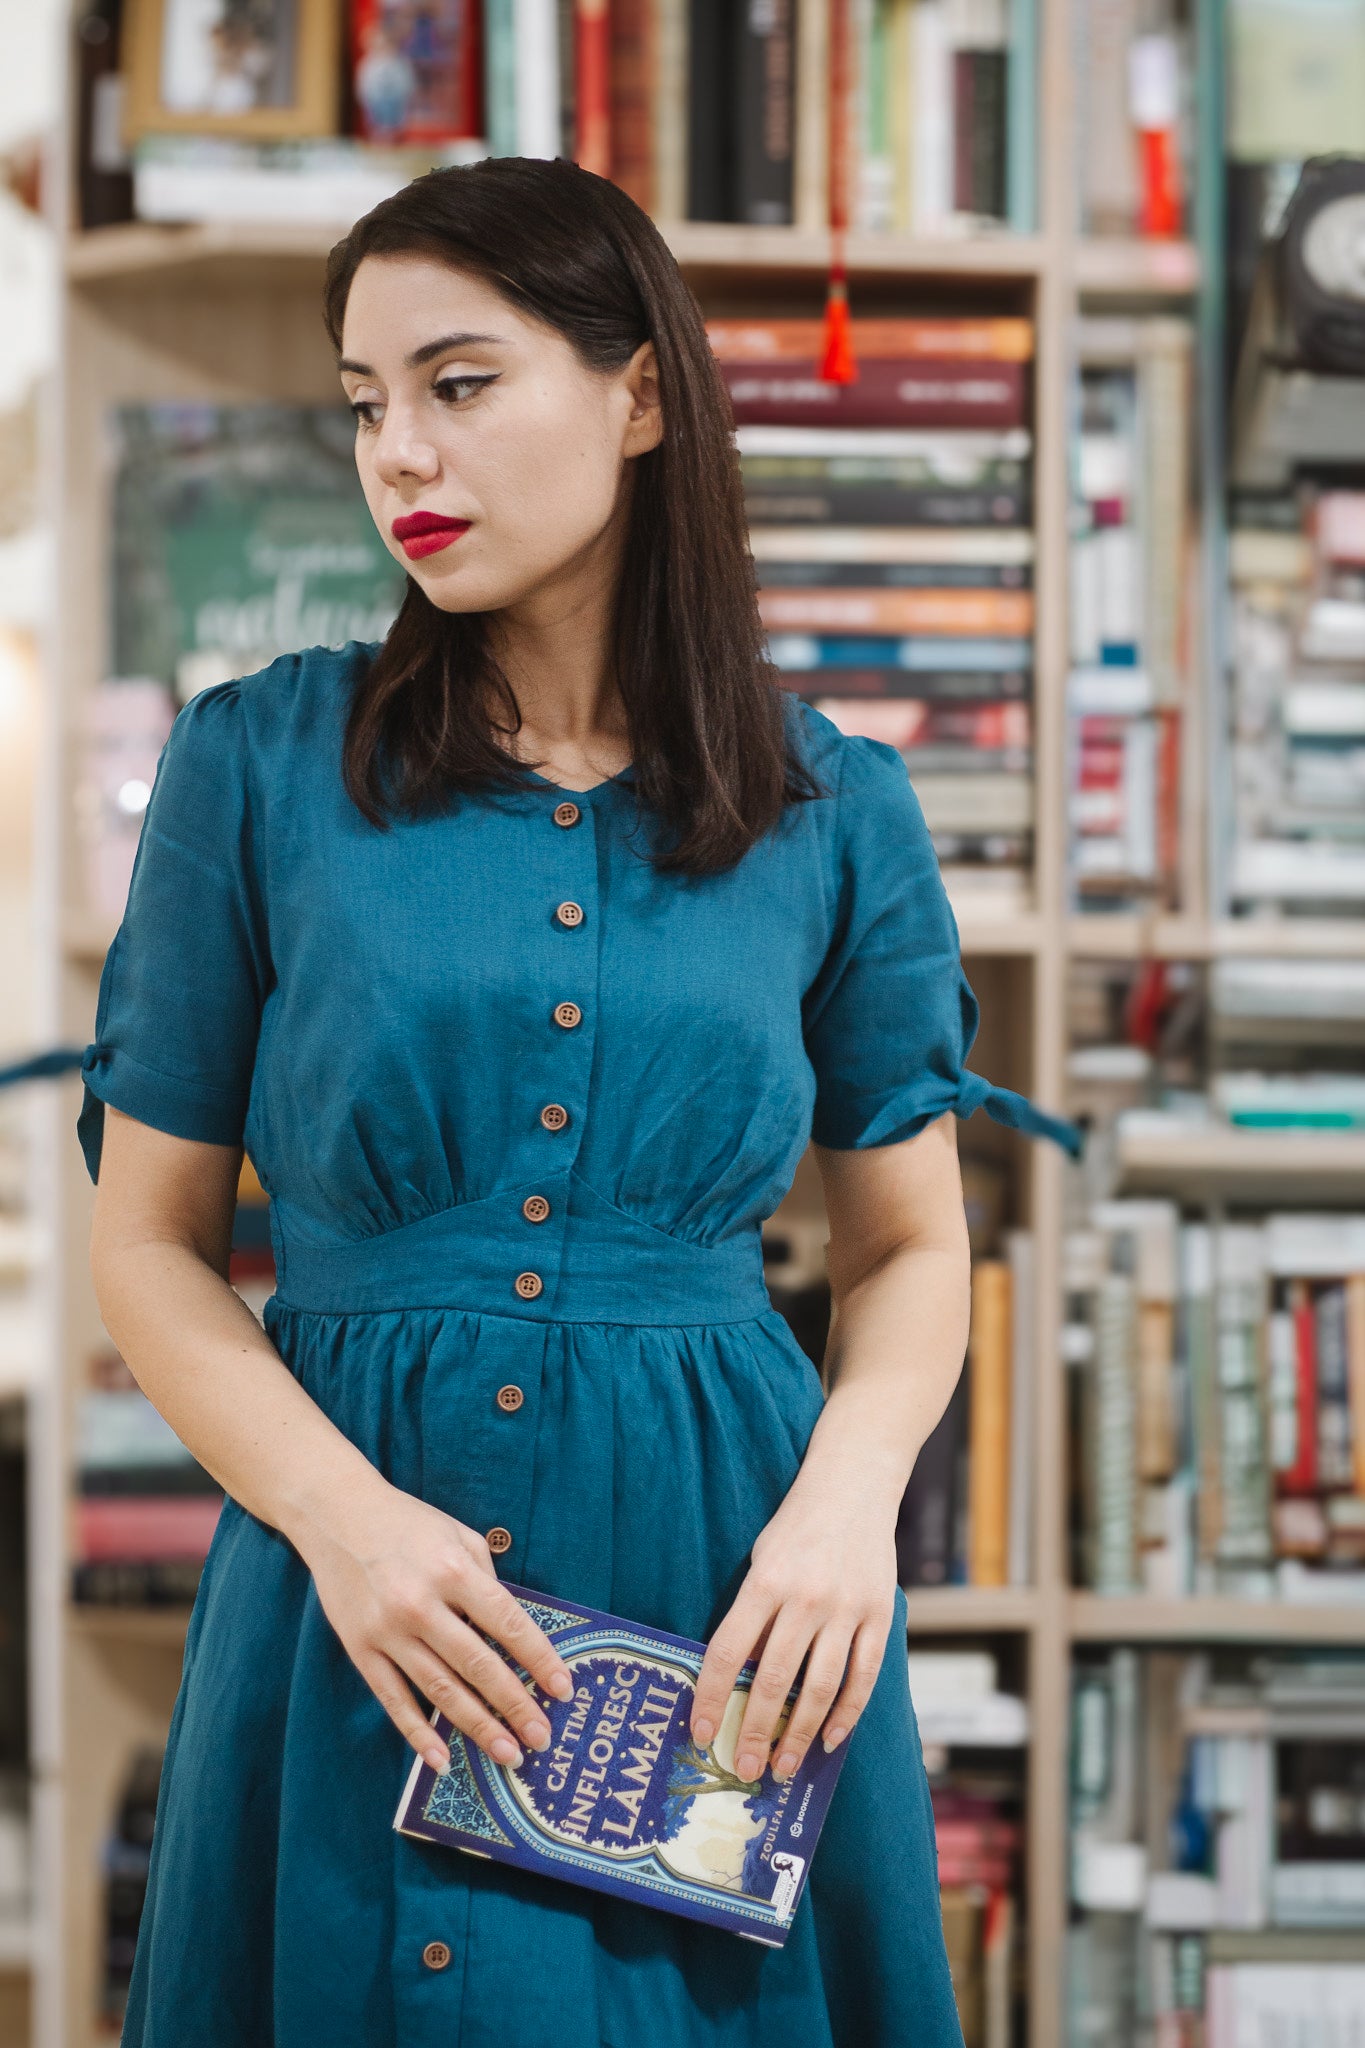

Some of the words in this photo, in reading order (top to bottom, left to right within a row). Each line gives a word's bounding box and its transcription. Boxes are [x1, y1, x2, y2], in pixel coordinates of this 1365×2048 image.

[560, 1686, 594, 1742] TIMP
[546, 1745, 575, 1792] CÂT
[560, 1665, 641, 1836] ÎNFLORESC
[601, 1683, 680, 1840] LĂMÂII
[796, 1783, 815, 1822] BOOKZONE
[760, 1809, 784, 1861] ZOULFA
